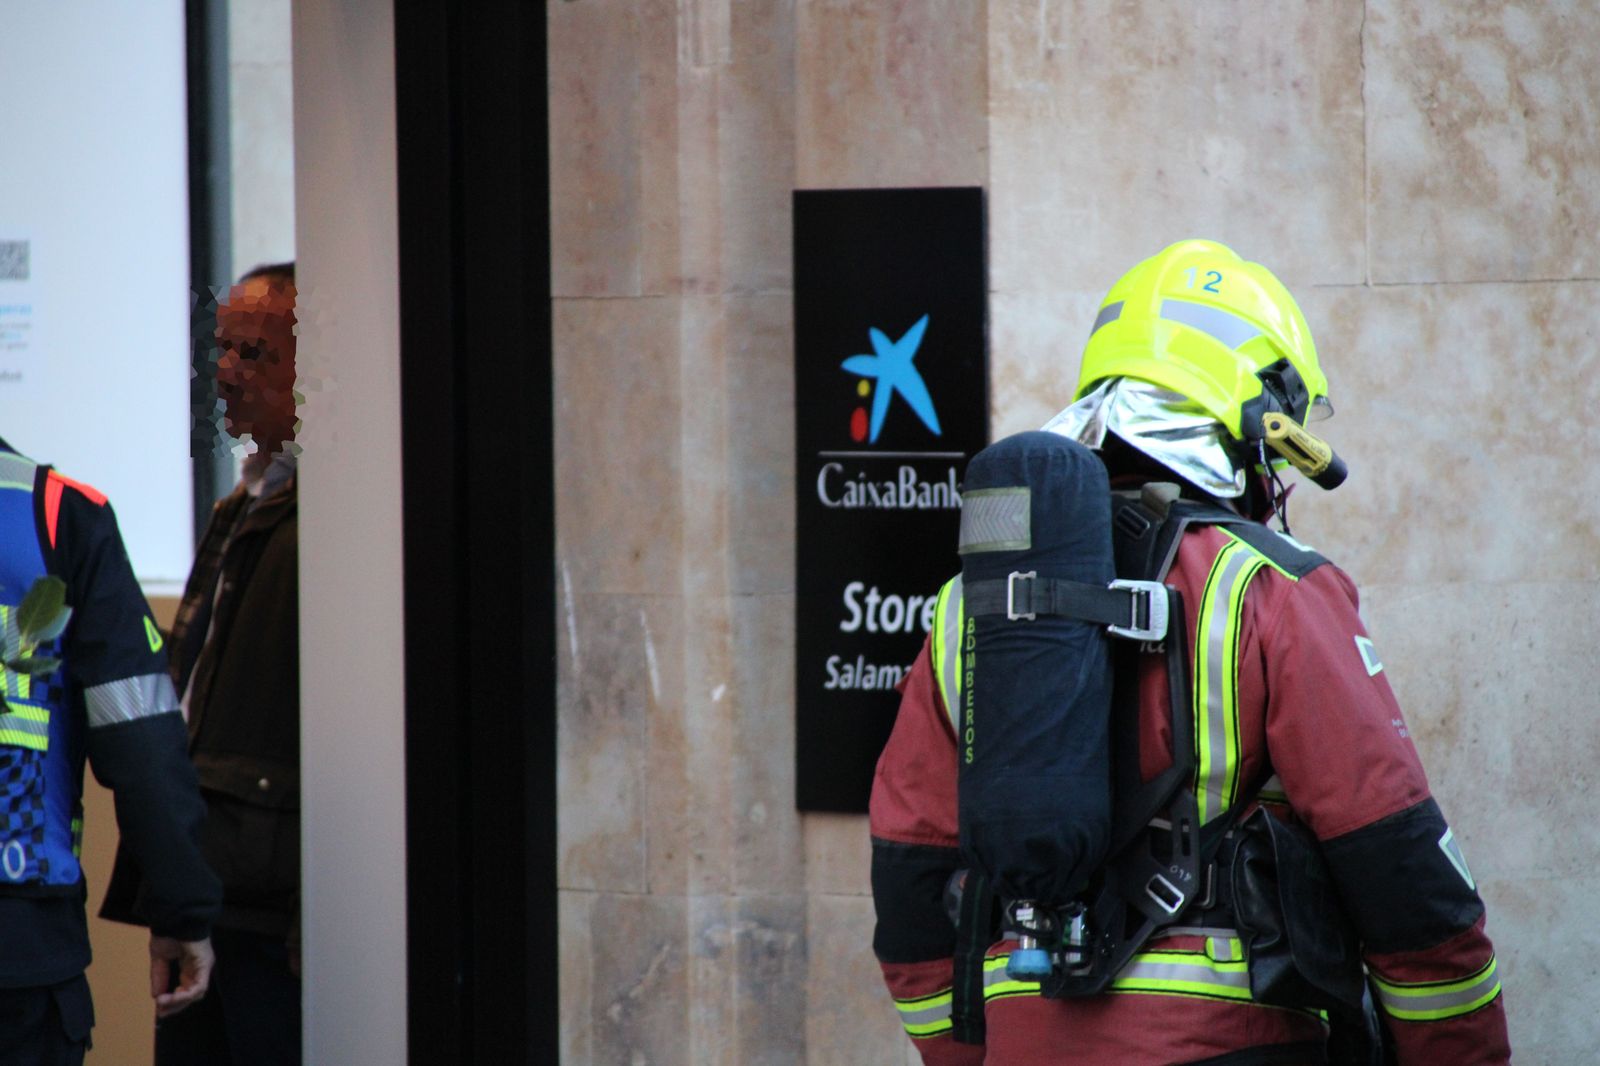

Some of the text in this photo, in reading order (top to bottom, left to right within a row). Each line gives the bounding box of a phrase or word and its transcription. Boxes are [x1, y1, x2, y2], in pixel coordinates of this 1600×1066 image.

[1183, 265, 1223, 294] 12
[816, 462, 963, 509] CaixaBank
[839, 581, 938, 633] Store
[823, 654, 912, 690] Salam
[964, 616, 977, 765] BOMBEROS
